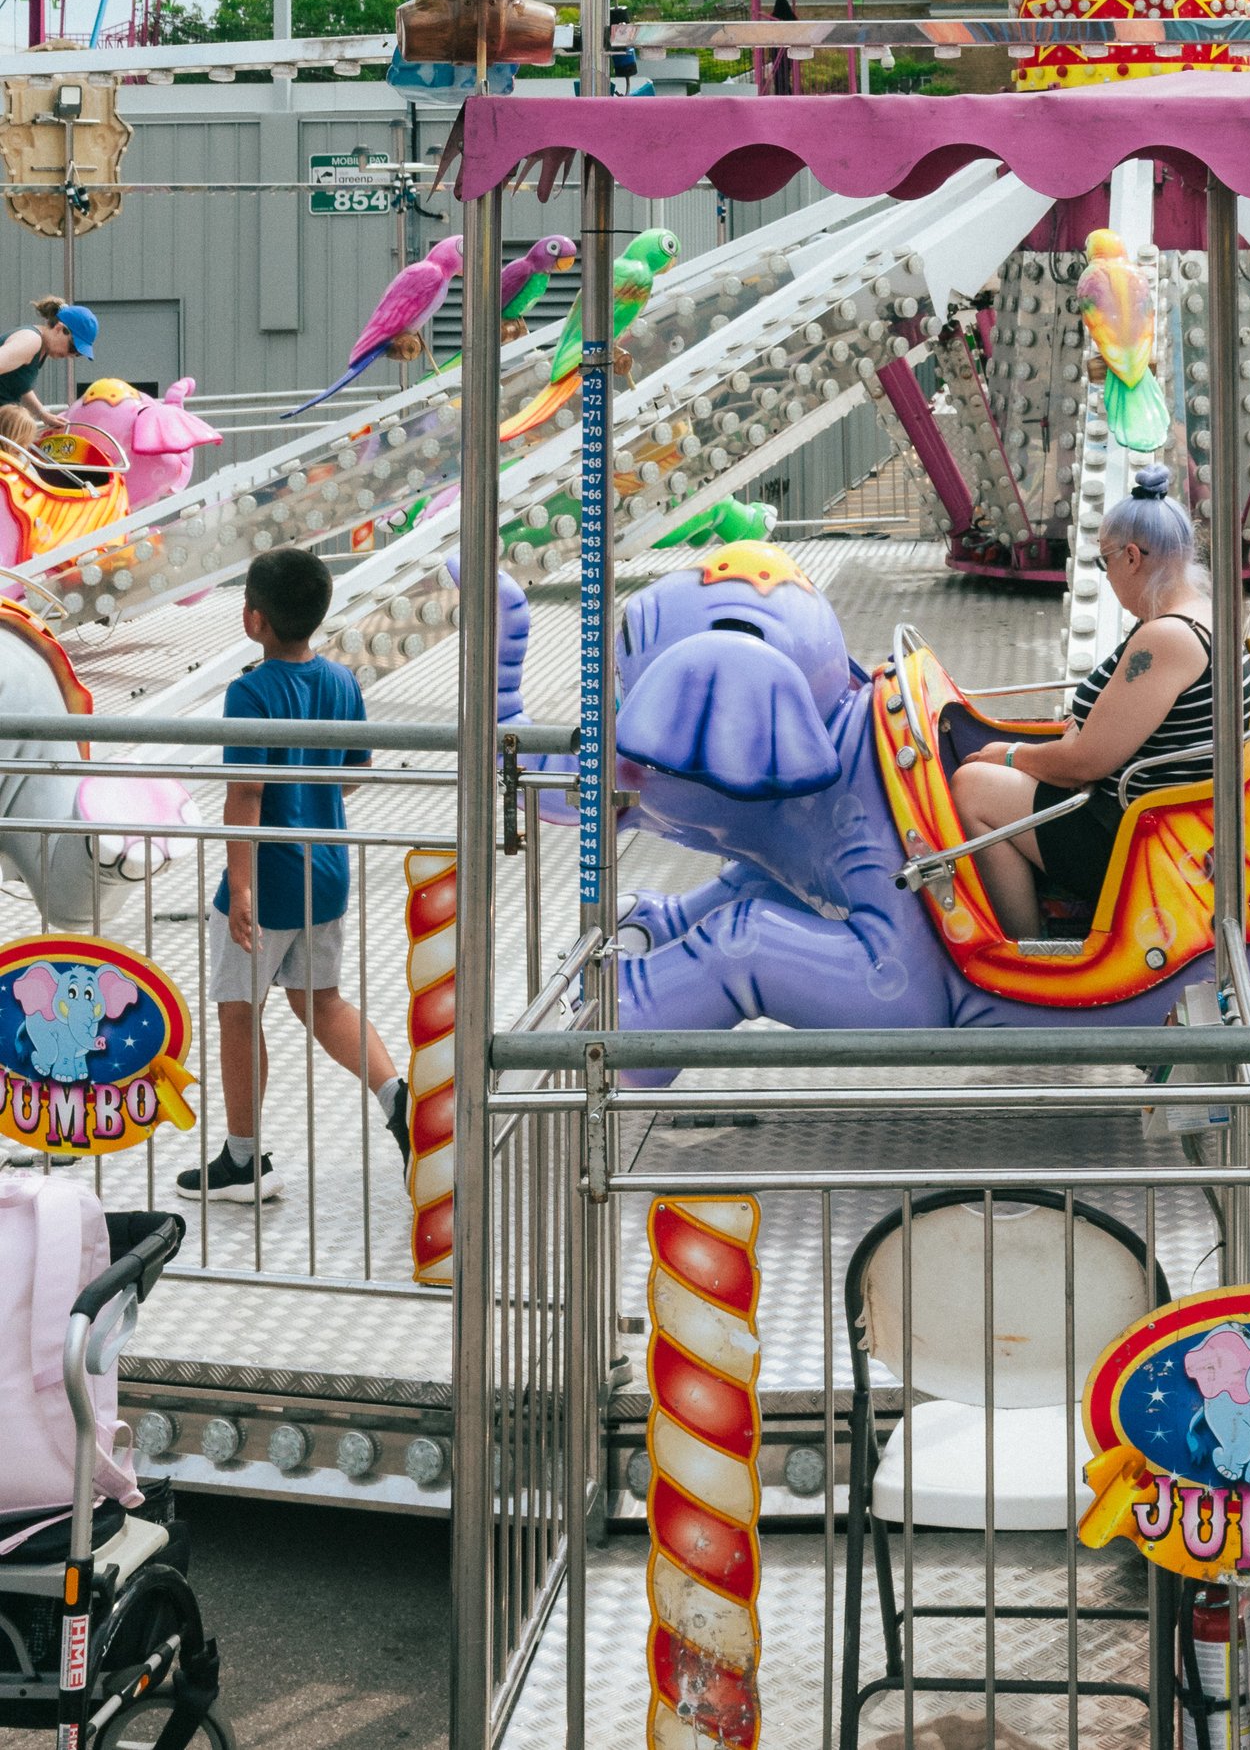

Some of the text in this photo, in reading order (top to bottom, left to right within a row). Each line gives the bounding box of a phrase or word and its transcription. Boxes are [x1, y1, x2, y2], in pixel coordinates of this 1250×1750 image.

[331, 156, 386, 165] MOBIL PAY
[334, 190, 387, 210] 854
[589, 379, 602, 388] 73
[589, 395, 602, 405] 72
[589, 411, 601, 420] 71
[589, 427, 602, 436] 70
[588, 458, 602, 468] 68
[588, 490, 601, 499] 66
[588, 506, 601, 515] 65
[588, 537, 601, 547] 63
[588, 568, 600, 578] 61
[588, 584, 600, 594] 60
[587, 632, 599, 641] 57
[586, 664, 599, 673] 55
[586, 680, 599, 689] 54
[586, 711, 598, 721] 52
[586, 727, 597, 736] 51
[586, 743, 598, 752] 50
[585, 775, 597, 784] 48
[585, 807, 597, 816] 46
[584, 823, 597, 832] 45
[584, 839, 597, 848] 44
[584, 855, 596, 864] 43
[584, 871, 596, 881] 42
[584, 887, 595, 897] 41
[0, 1070, 159, 1148] UMBO
[70, 1620, 85, 1686] HME
[69, 1727, 78, 1750] HM
